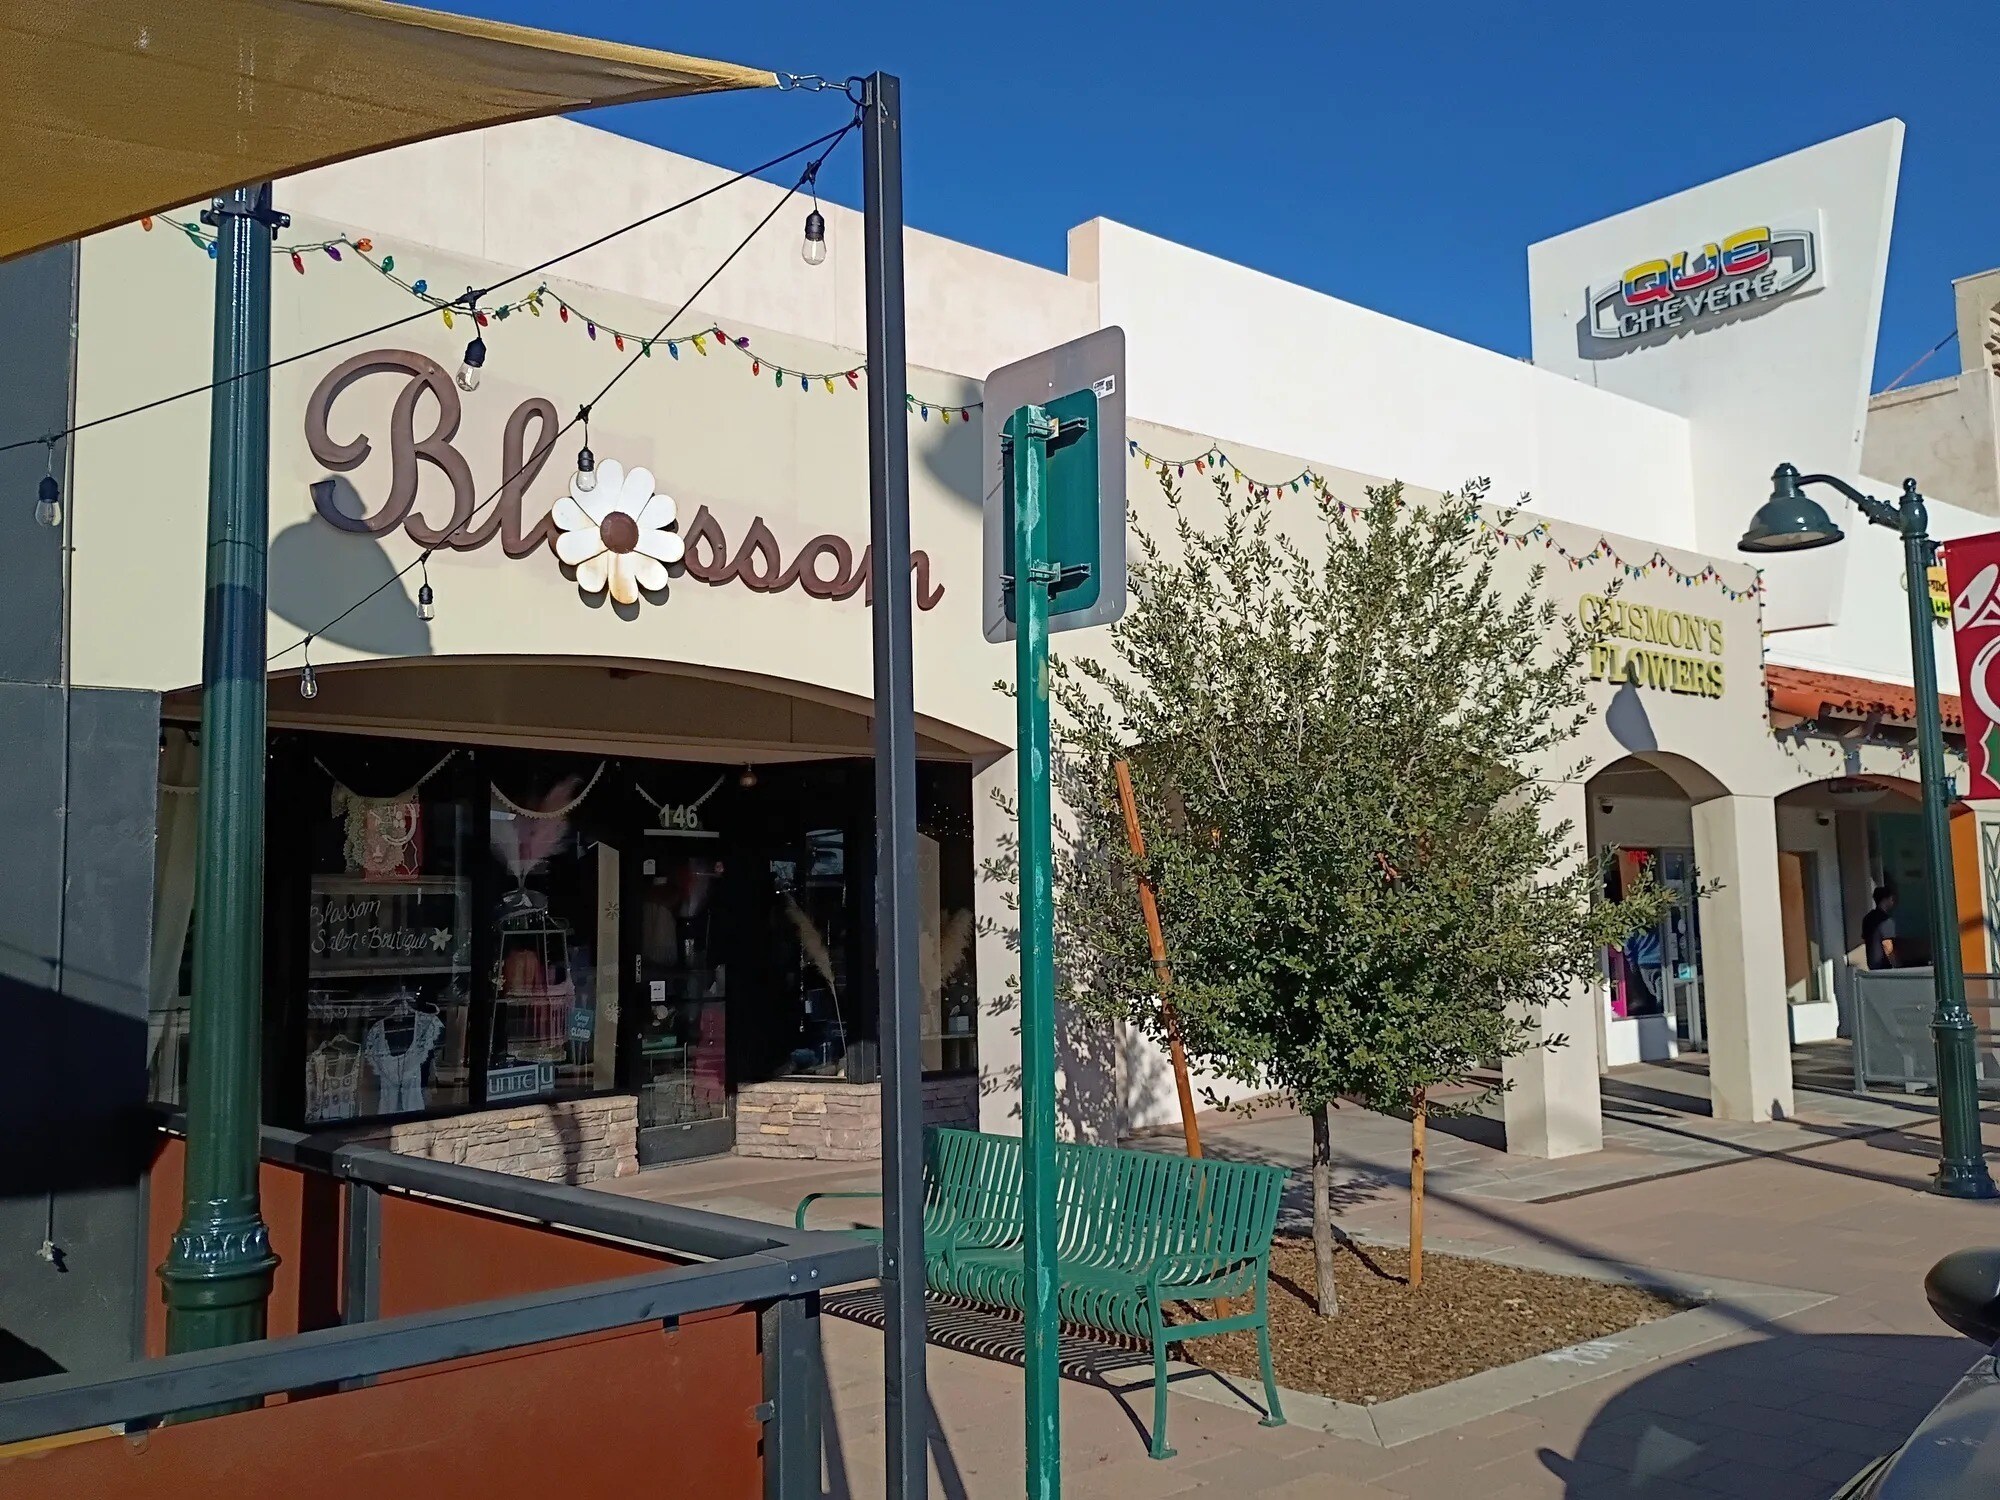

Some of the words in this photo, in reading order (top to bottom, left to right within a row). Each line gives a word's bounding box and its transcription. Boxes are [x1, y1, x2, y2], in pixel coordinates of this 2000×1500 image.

[1622, 227, 1771, 306] QUE
[1620, 271, 1777, 337] CHEVERE
[304, 348, 945, 612] Blssom
[1579, 592, 1725, 656] CRISMON'S
[1589, 641, 1725, 699] FLOWERS
[660, 803, 698, 829] 146
